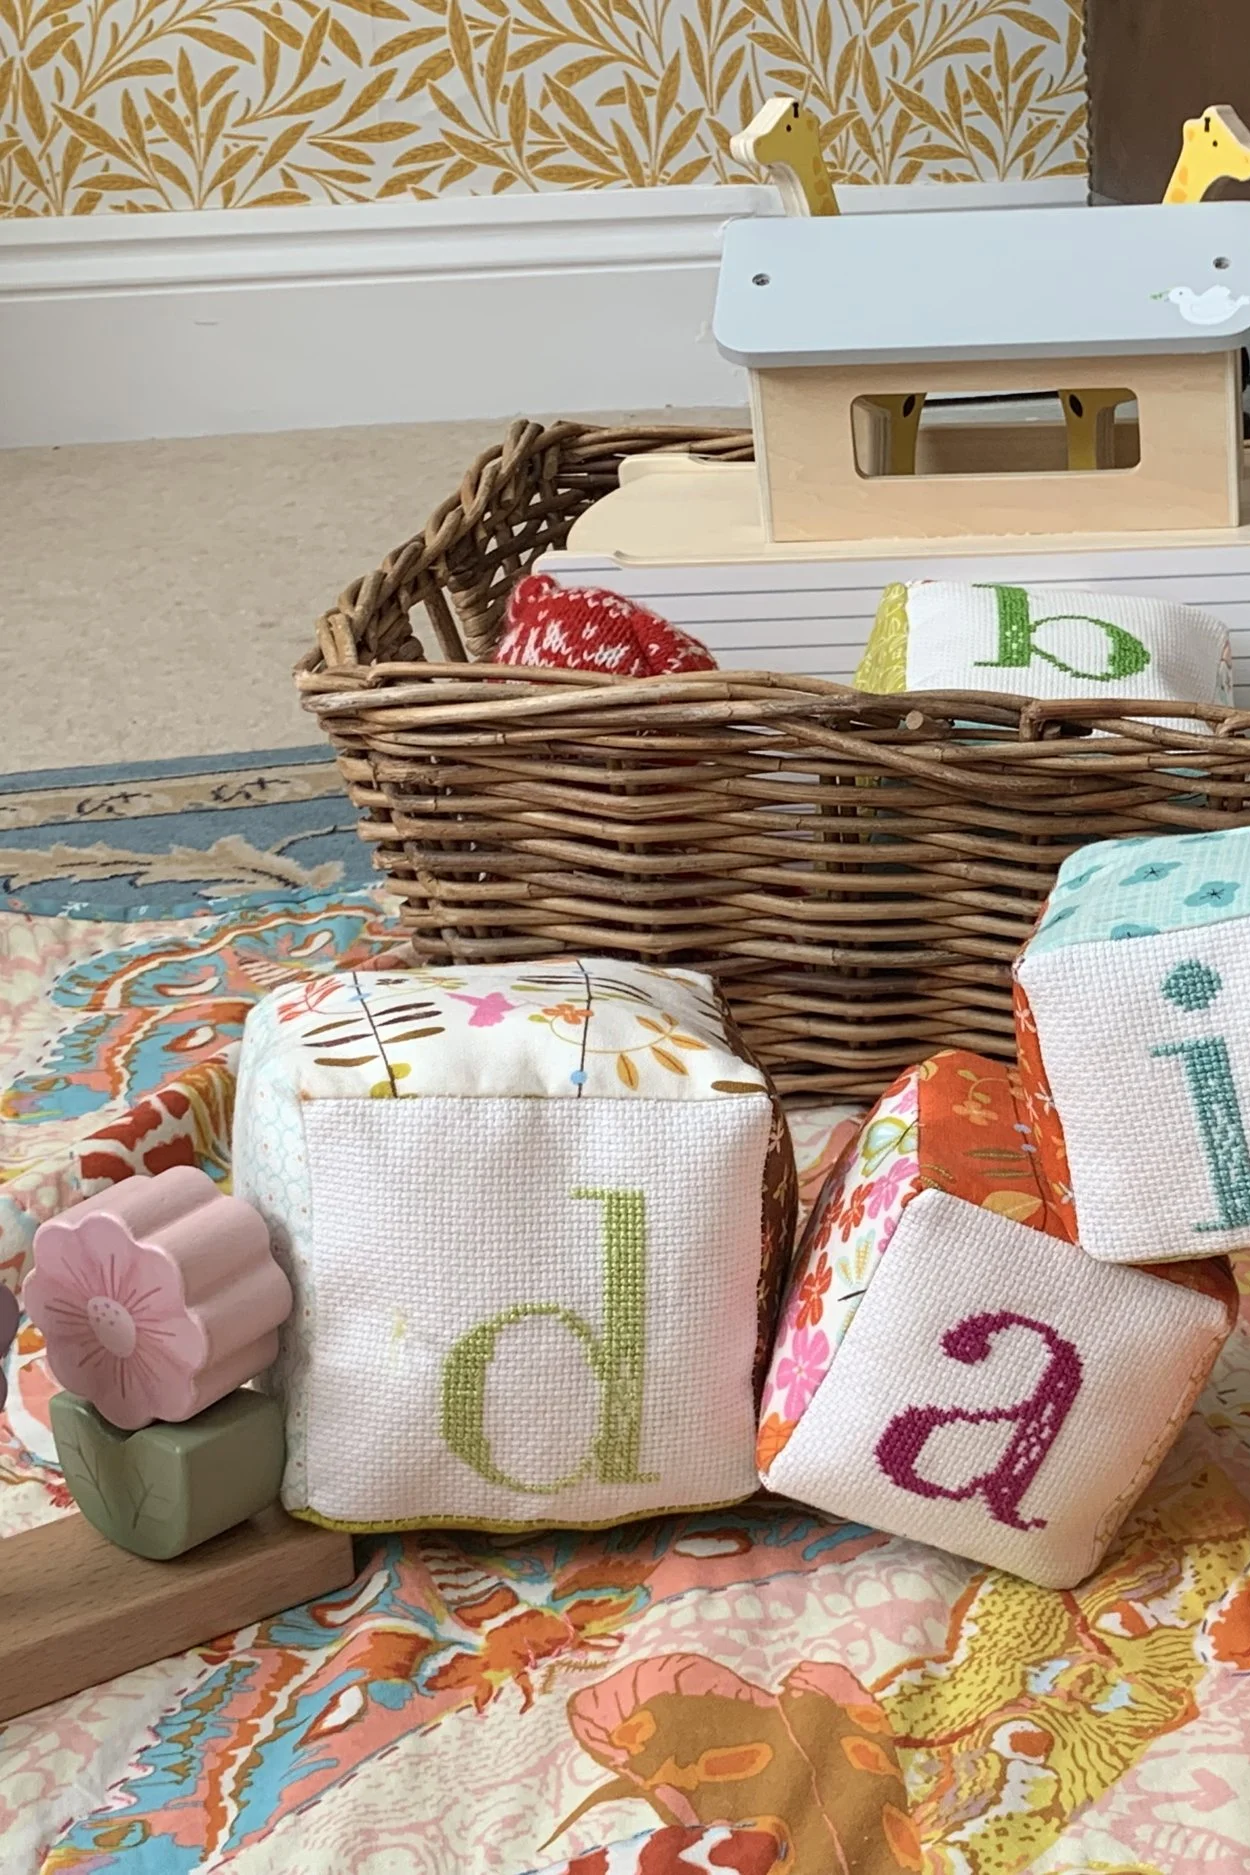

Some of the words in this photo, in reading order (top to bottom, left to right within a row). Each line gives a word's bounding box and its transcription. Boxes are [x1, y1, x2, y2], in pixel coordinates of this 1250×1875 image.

[972, 583, 1150, 682] b
[440, 1187, 661, 1494] d
[874, 1311, 1084, 1533] a
